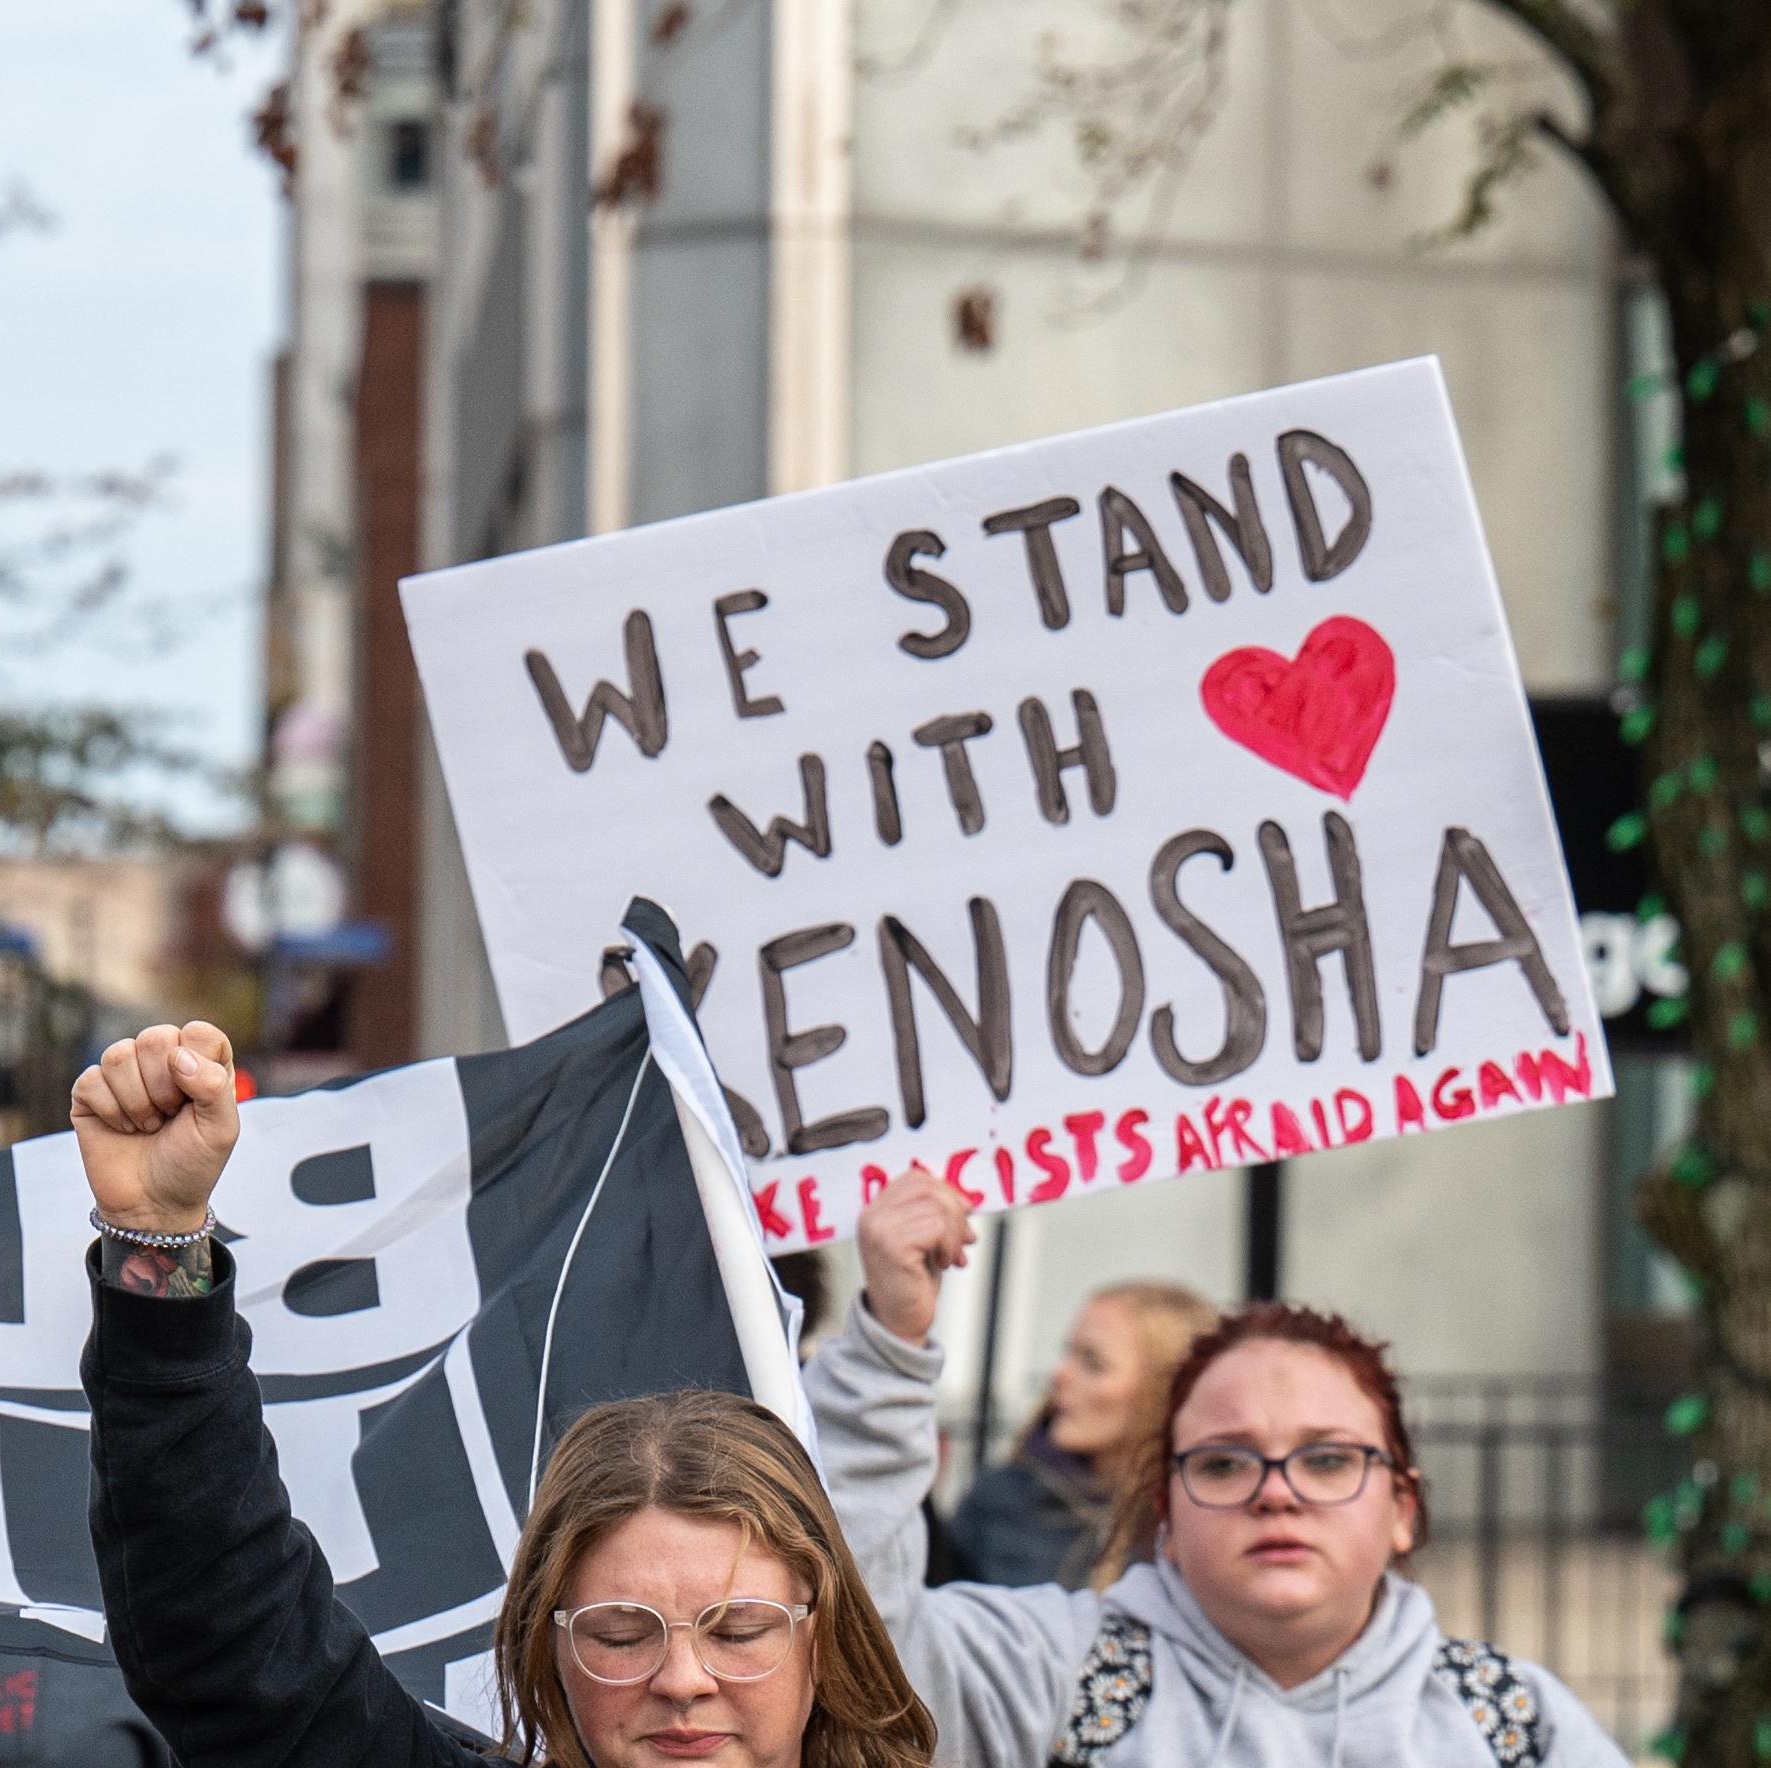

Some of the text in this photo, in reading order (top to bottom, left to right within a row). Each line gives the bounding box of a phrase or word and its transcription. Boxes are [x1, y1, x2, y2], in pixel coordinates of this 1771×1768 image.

[523, 428, 1373, 774] WE STAND
[707, 687, 1121, 877] WITH
[861, 1107, 1151, 1210] CISTS
[1175, 1086, 1375, 1176] AFRAID
[1393, 1031, 1593, 1137] AGAIN
